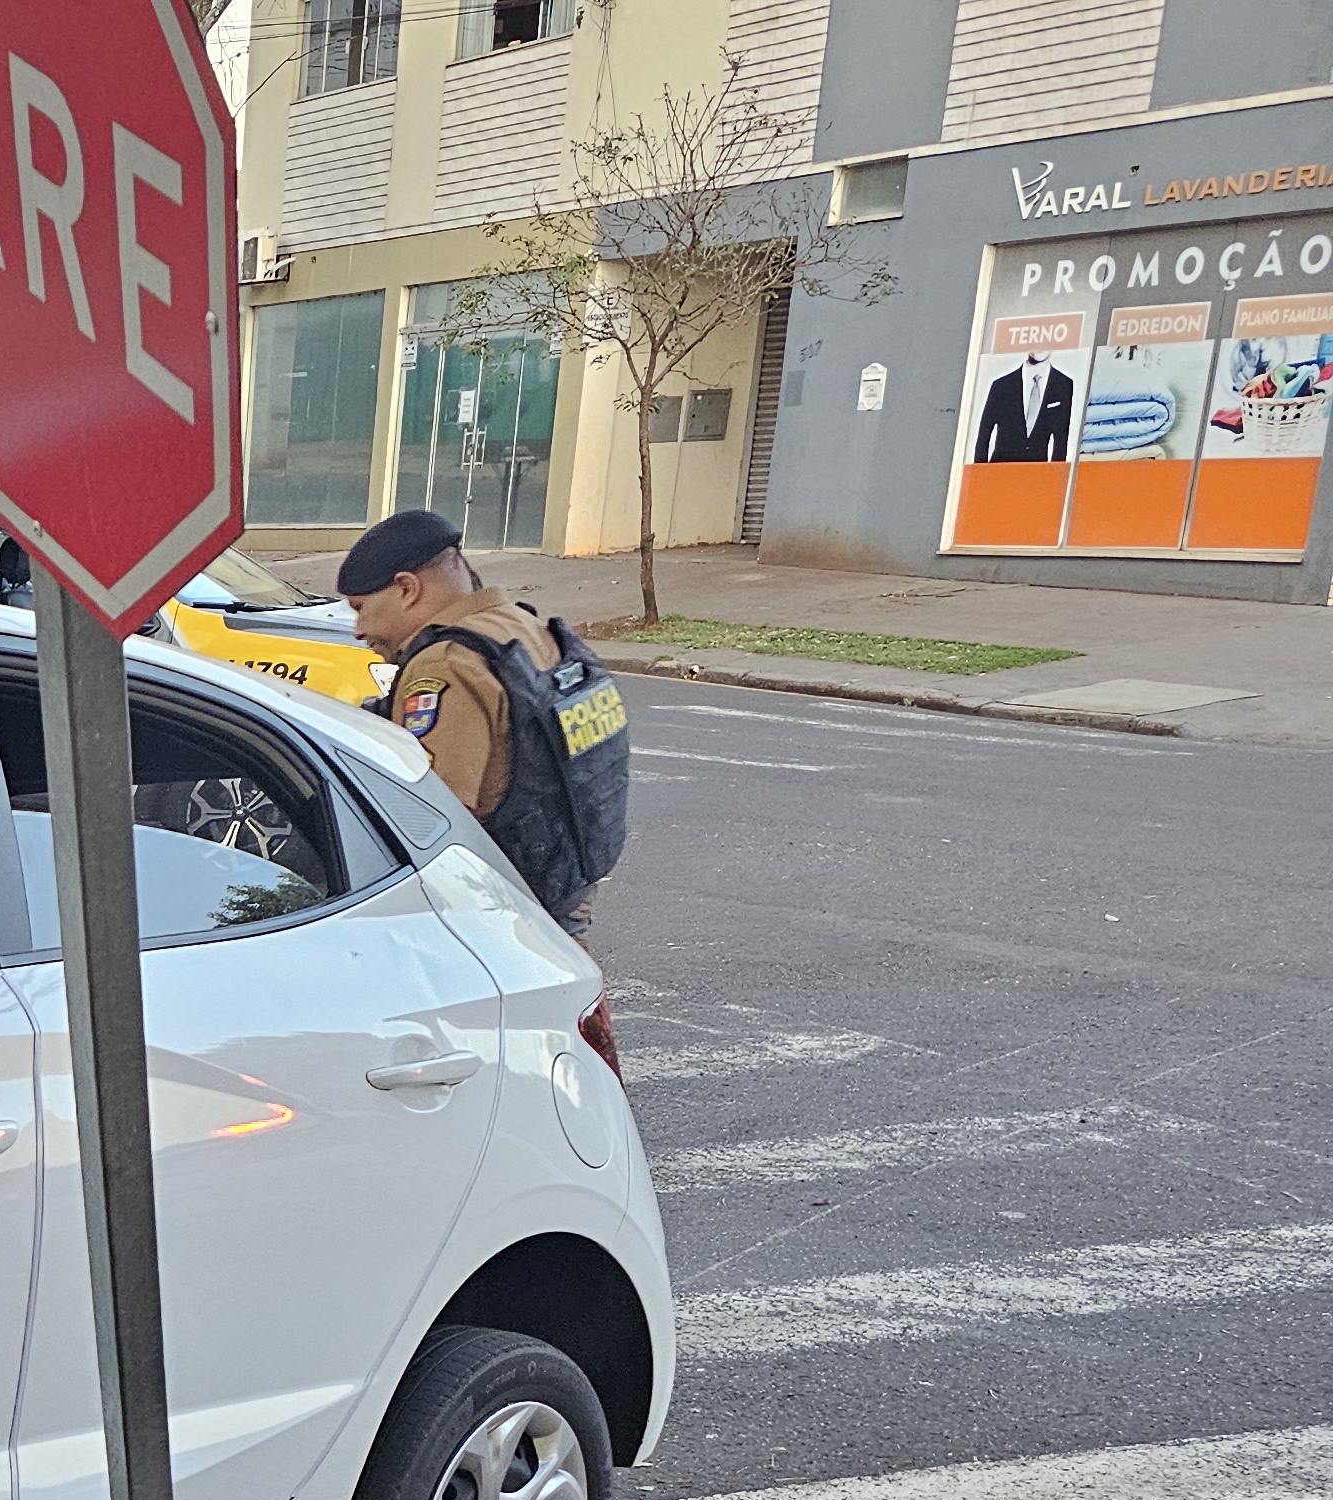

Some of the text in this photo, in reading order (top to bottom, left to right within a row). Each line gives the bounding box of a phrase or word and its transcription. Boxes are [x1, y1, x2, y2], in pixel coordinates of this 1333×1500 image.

[1012, 161, 1132, 219] VARAL
[1021, 229, 1332, 297] PROMOÇÃO
[1116, 314, 1202, 338] EDREDON
[1240, 306, 1333, 326] PLANO FAMILIA
[1009, 323, 1068, 345] TERNO
